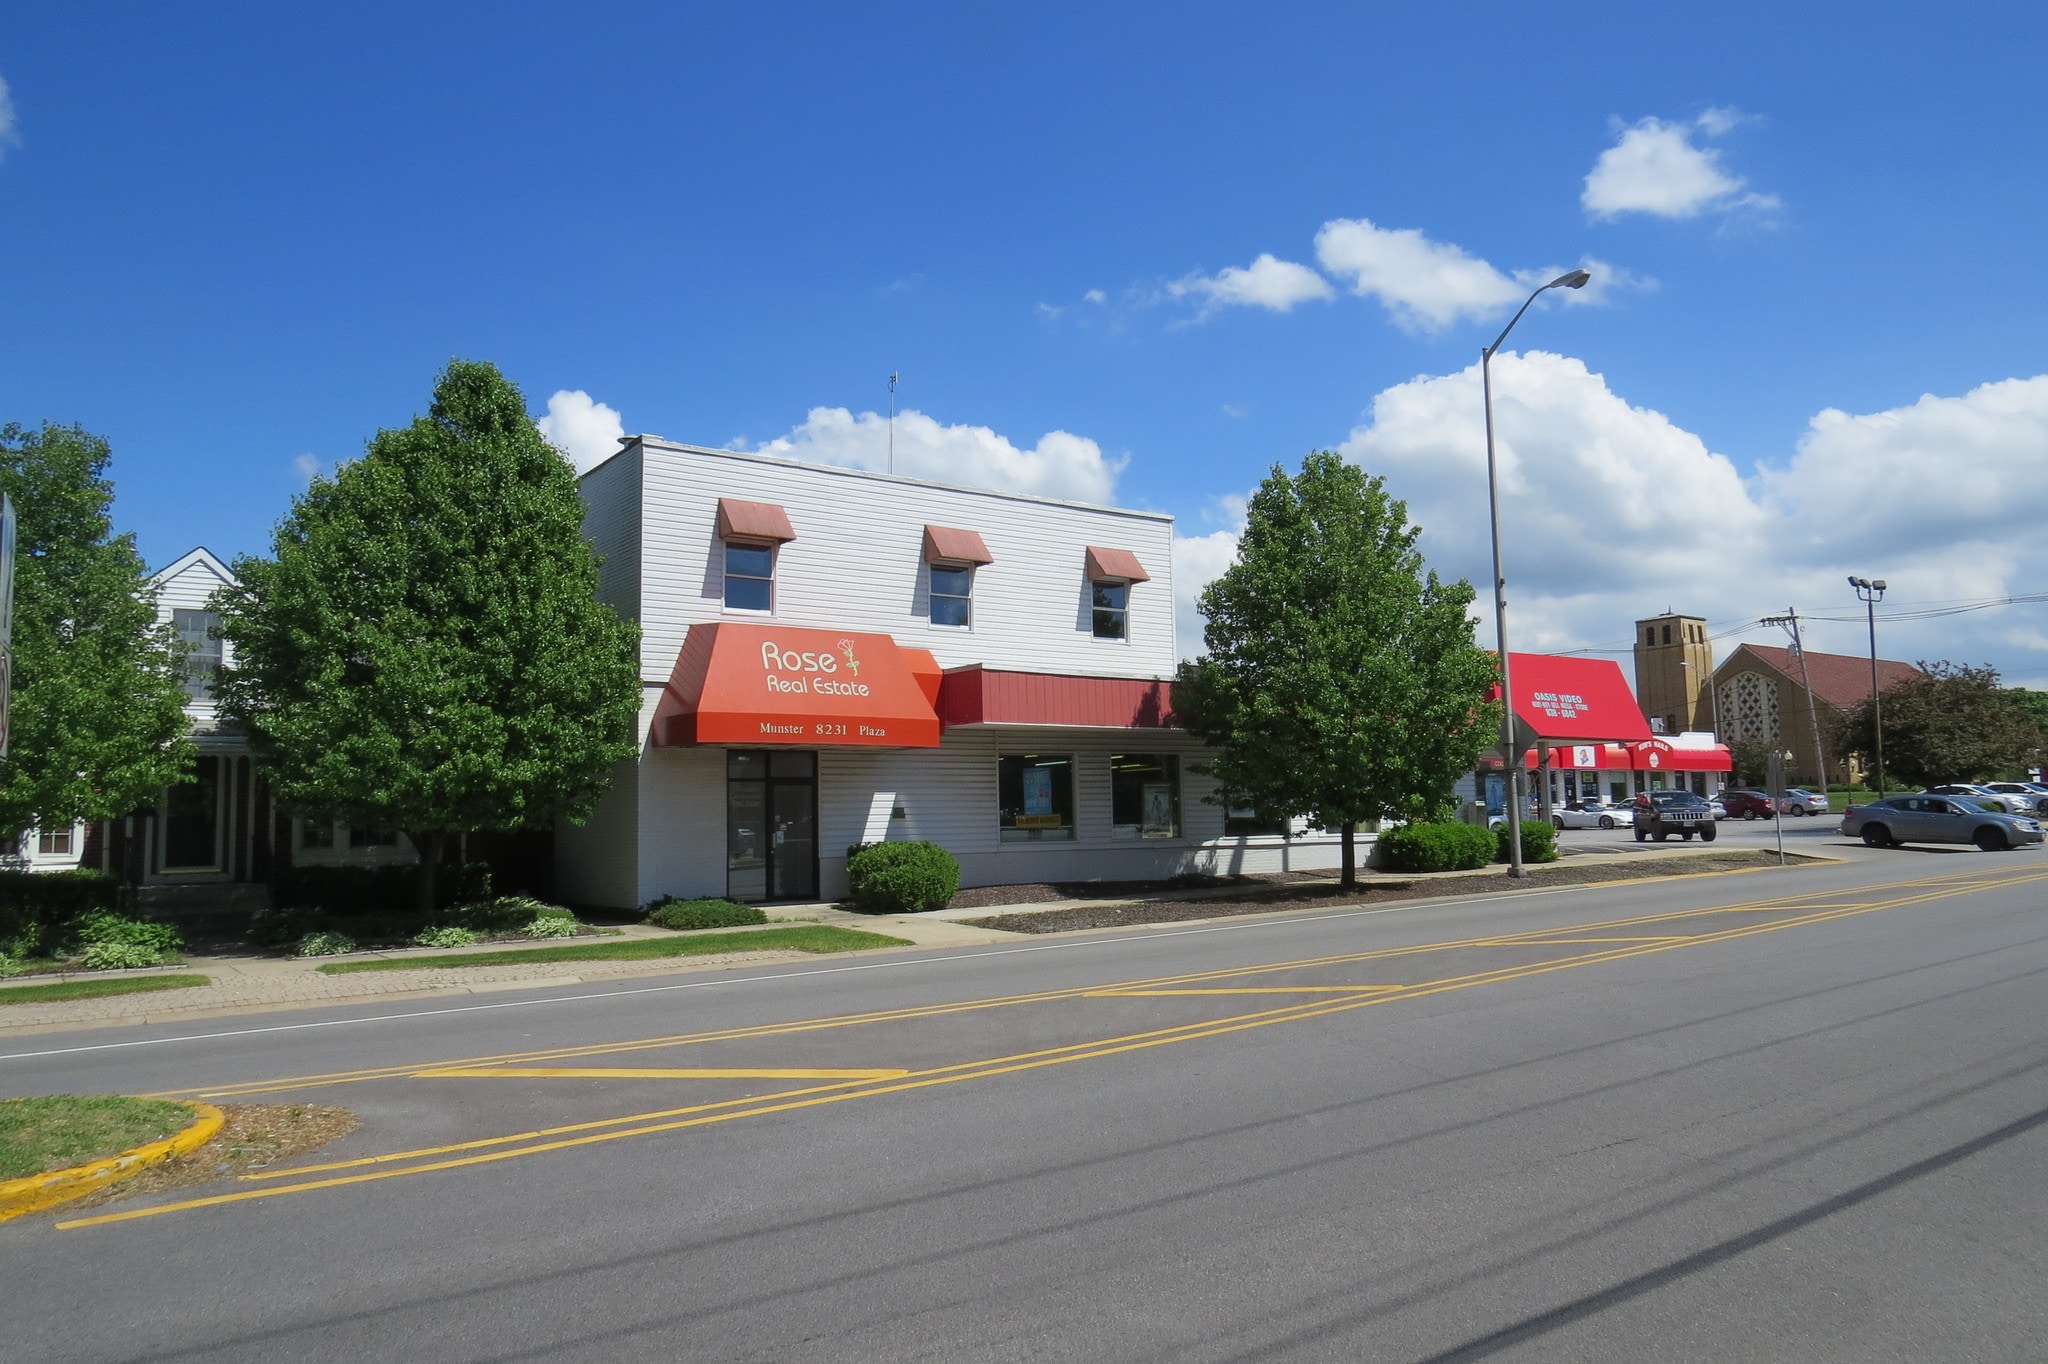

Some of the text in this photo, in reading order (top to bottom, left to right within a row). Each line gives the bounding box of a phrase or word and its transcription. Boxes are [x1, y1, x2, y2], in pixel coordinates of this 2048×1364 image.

[761, 641, 838, 673] Rose
[766, 674, 870, 697] Real Estate
[1534, 692, 1583, 704] OASIS VIDEO
[760, 722, 886, 737] Munster 8231 Plaza
